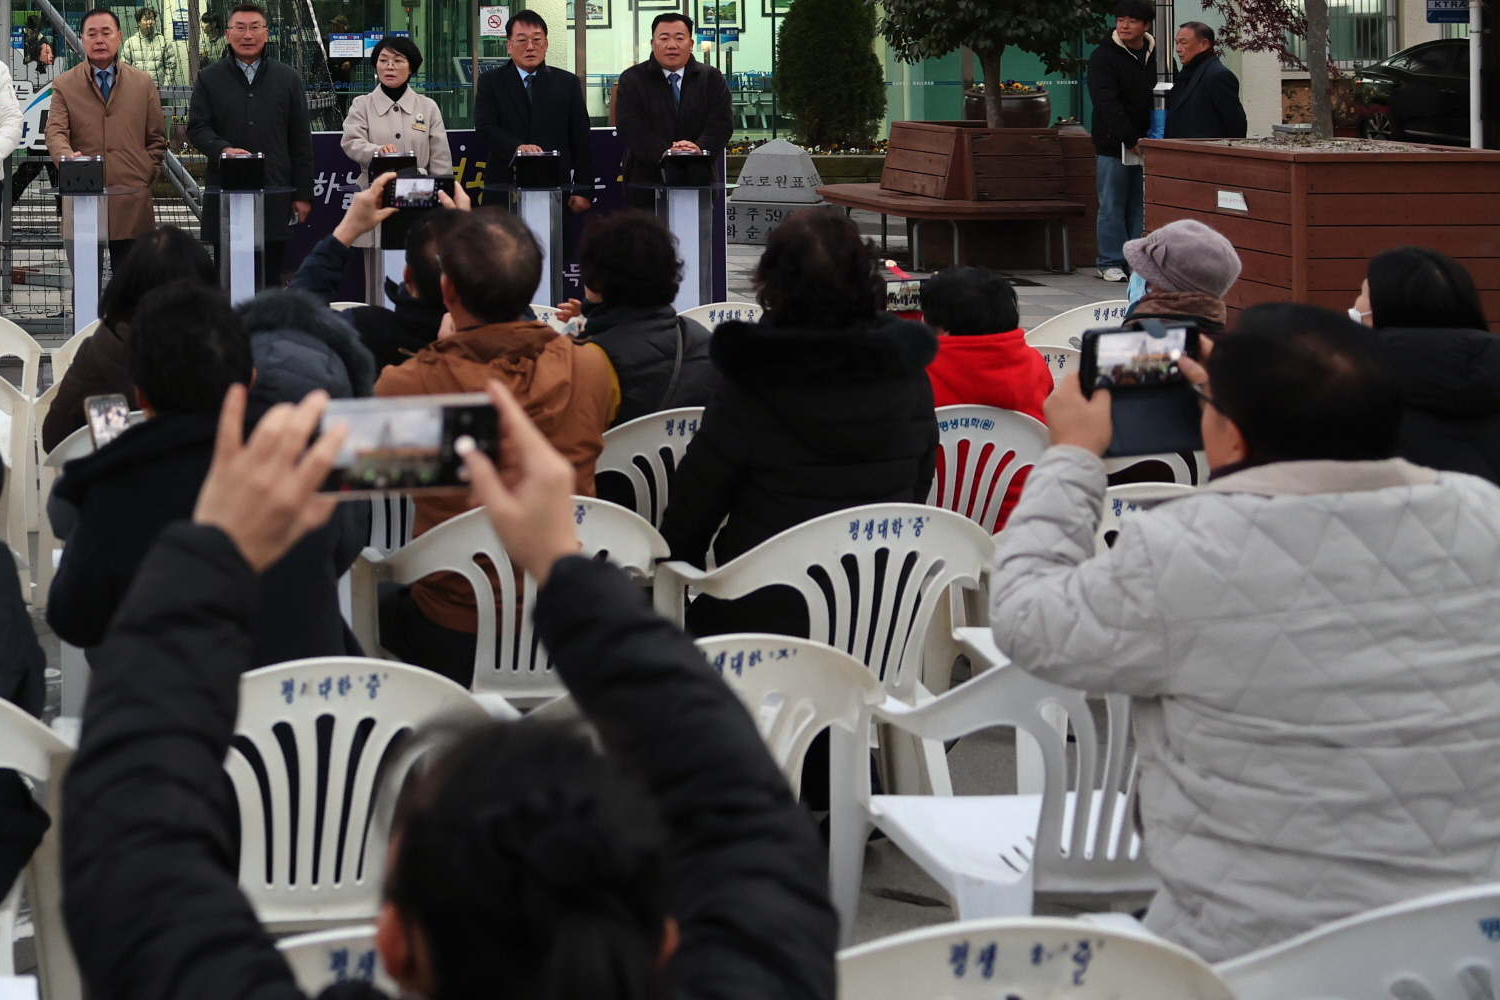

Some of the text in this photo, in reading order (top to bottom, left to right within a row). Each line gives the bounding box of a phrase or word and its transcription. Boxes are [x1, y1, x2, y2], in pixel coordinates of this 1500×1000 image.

[739, 174, 805, 189] 도로원표
[665, 418, 701, 436] 평생대
[849, 517, 903, 540] 평생대학
